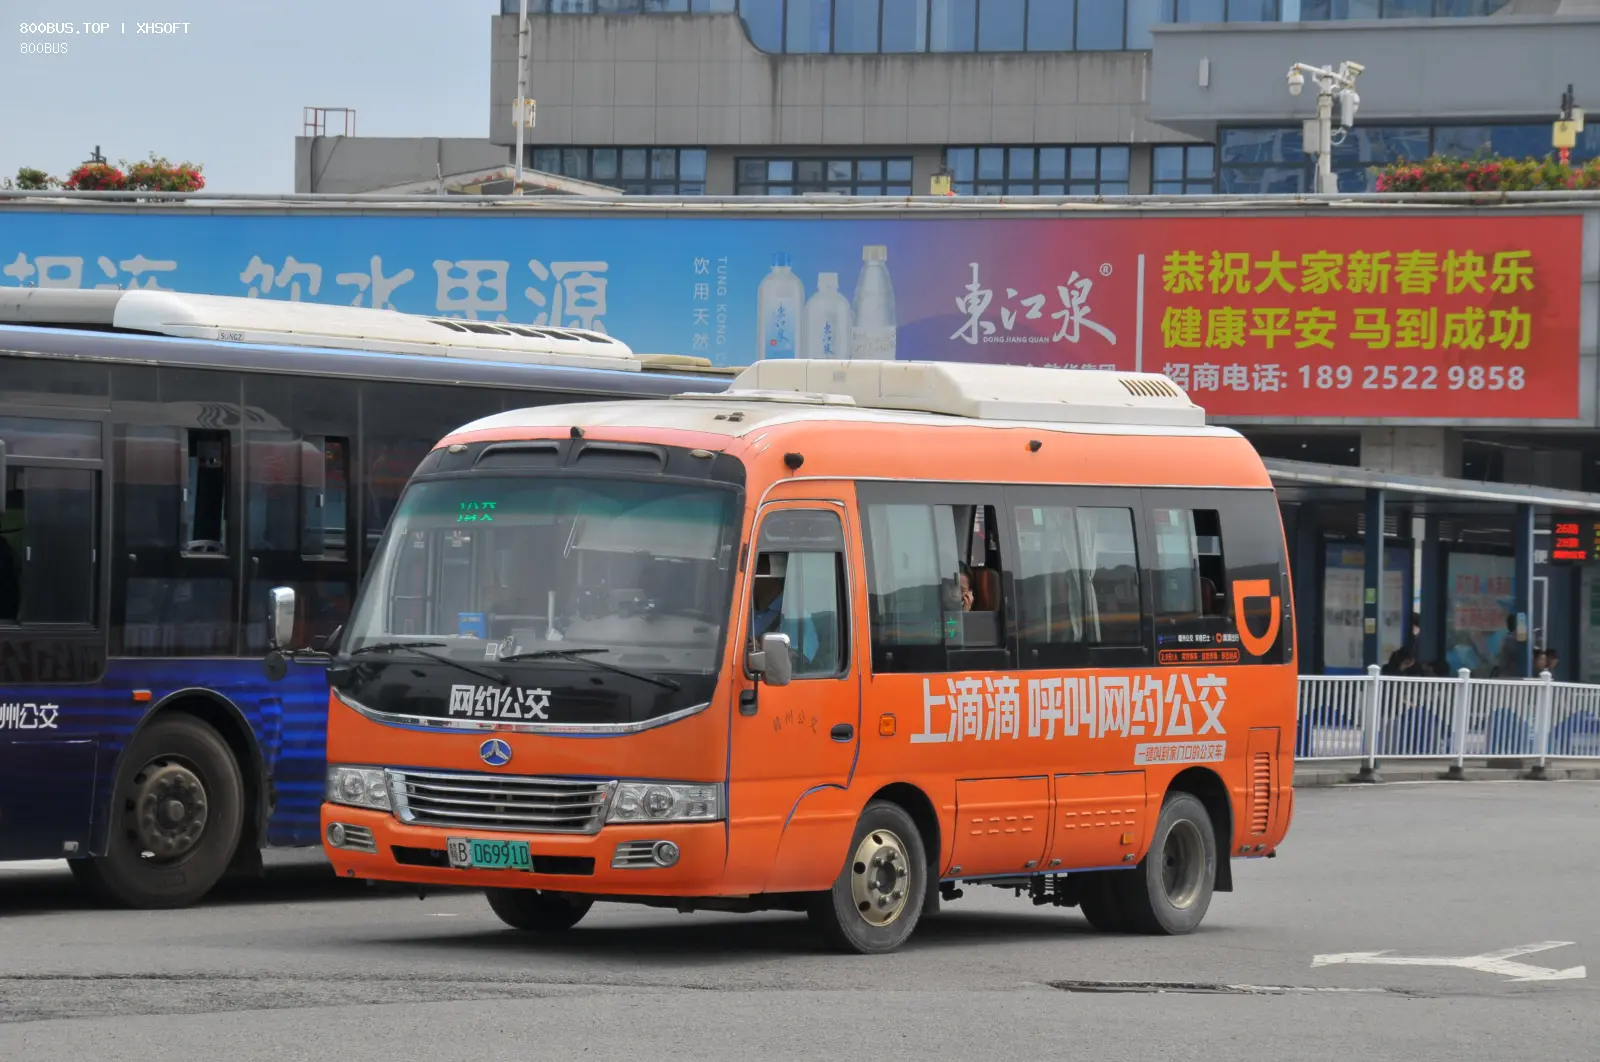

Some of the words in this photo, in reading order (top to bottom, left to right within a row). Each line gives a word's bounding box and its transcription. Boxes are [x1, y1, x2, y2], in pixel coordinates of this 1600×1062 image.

[716, 256, 728, 296] TUNG
[1161, 250, 1535, 295] 恭祝大家新春快乐
[716, 304, 728, 346] KONG
[983, 336, 1005, 344] DONG
[1005, 336, 1027, 344] JIANG
[1028, 336, 1050, 344] QUAN
[1161, 306, 1337, 350] 健康平安
[1348, 306, 1531, 351] 马到成功
[1298, 364, 1353, 390] 189
[1362, 364, 1438, 390] 2522
[1447, 365, 1526, 391] 9858
[448, 684, 552, 720] 网约公交
[910, 675, 1020, 743] 上滴滴
[1028, 673, 1227, 740] 呼叫网约公交
